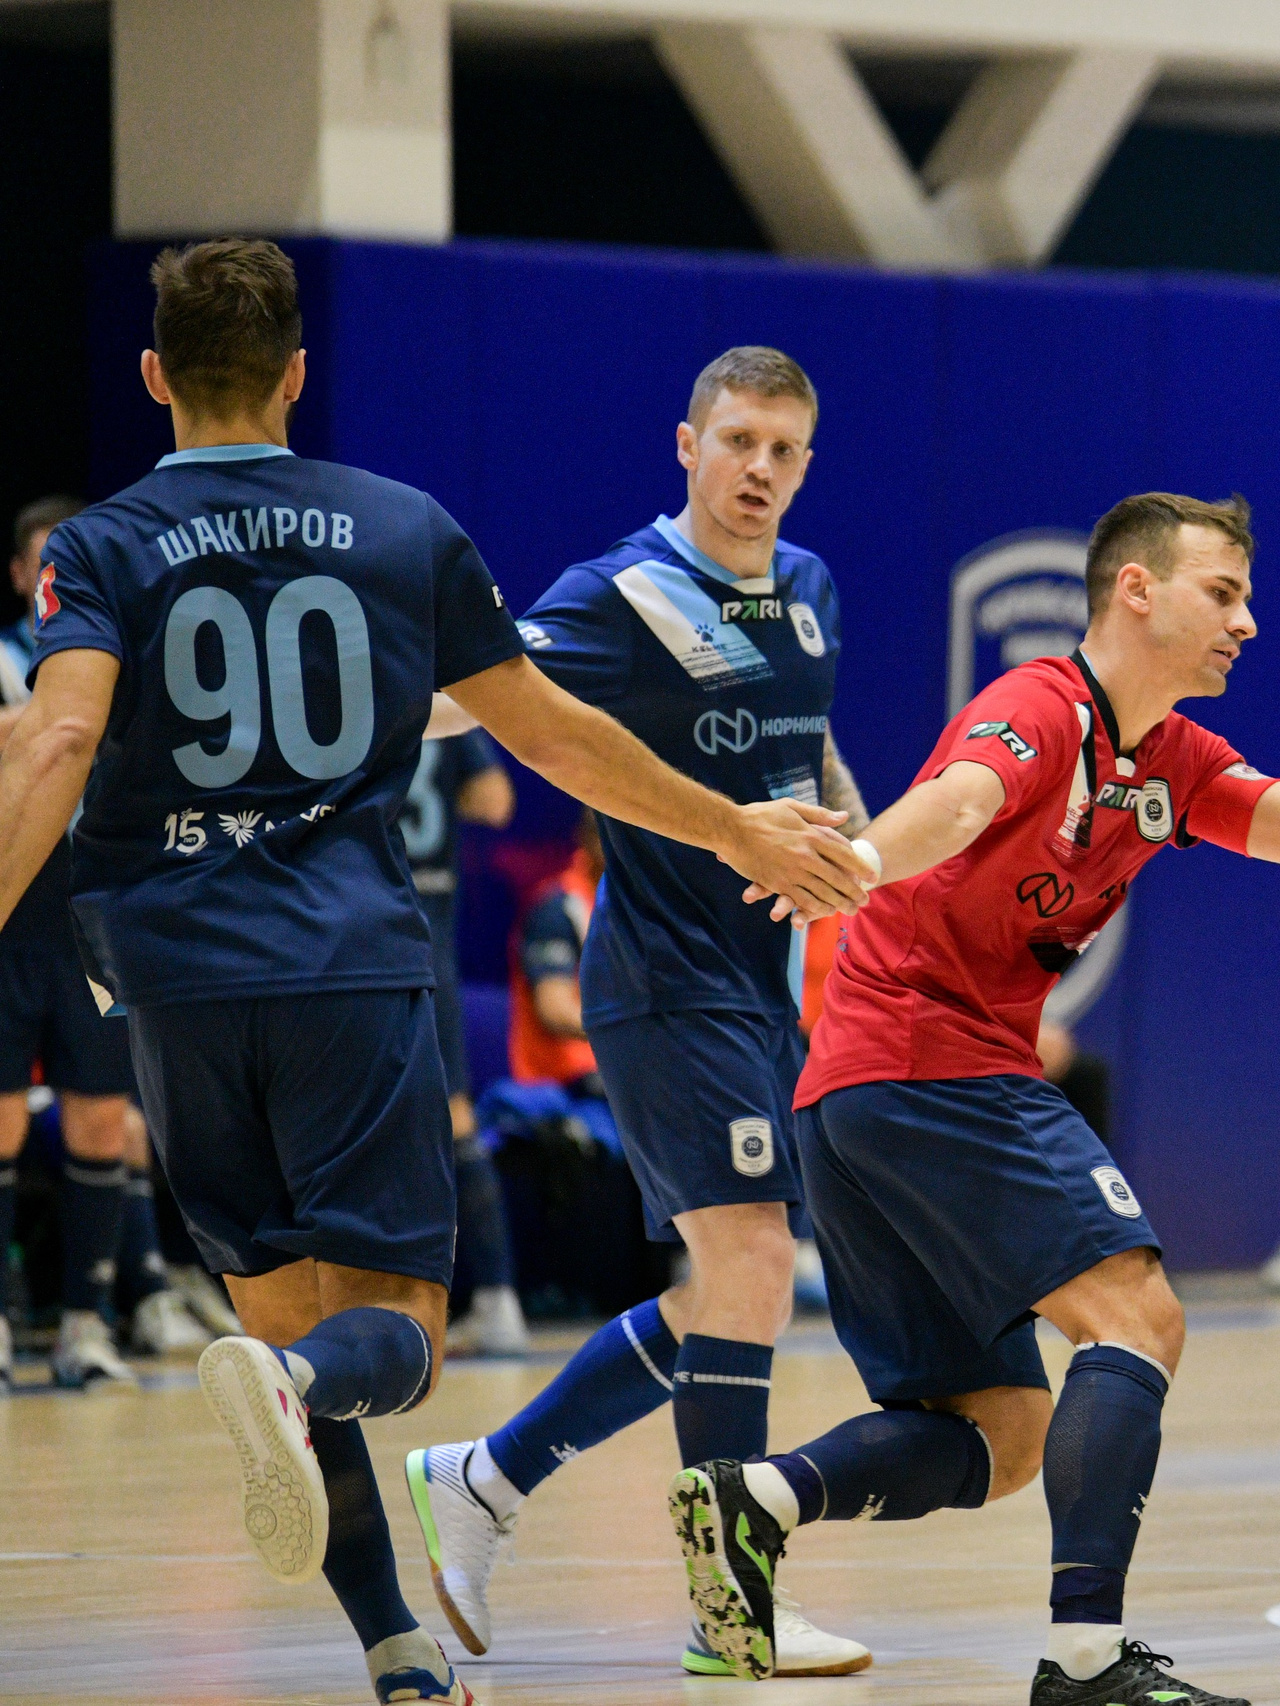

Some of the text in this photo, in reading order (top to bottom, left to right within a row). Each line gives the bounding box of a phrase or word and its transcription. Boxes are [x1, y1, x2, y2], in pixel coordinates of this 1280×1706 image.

[157, 507, 354, 567] ШАКИРОВ
[722, 599, 782, 622] PARI
[164, 575, 375, 788] 90
[164, 808, 208, 856] 15
